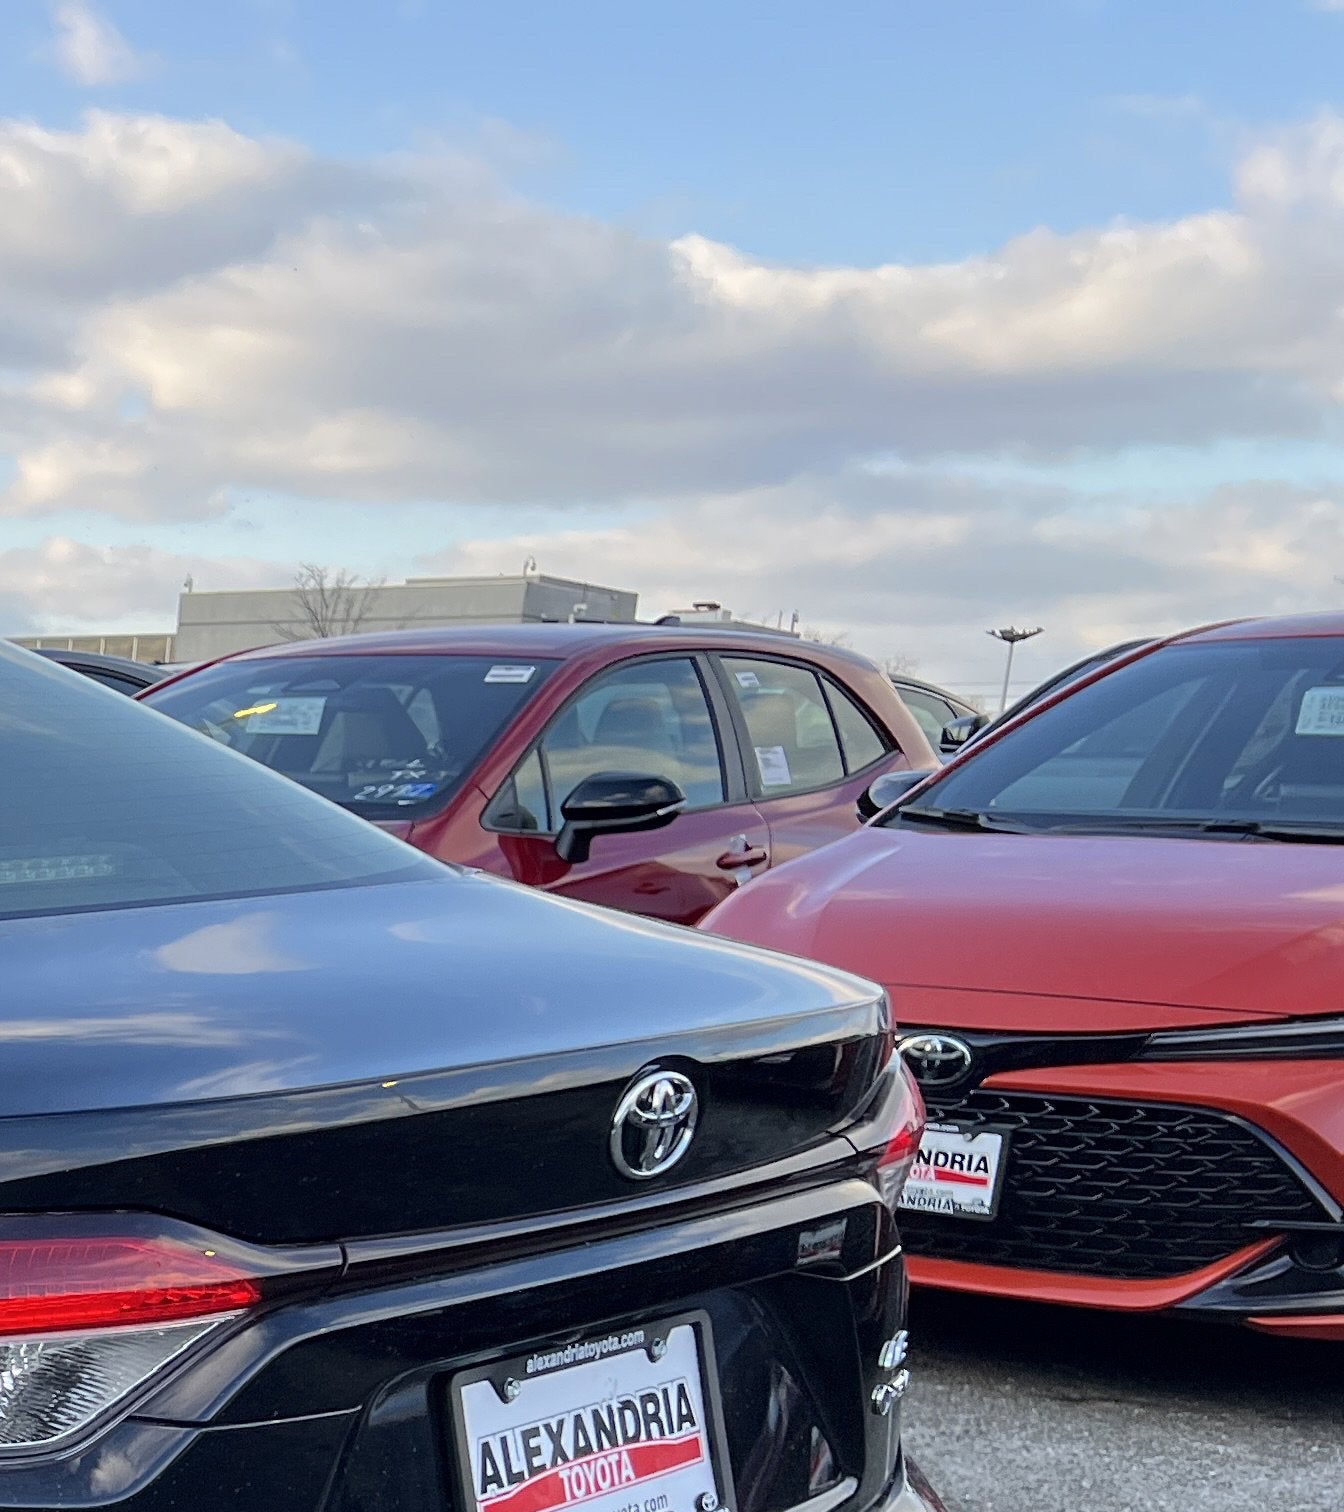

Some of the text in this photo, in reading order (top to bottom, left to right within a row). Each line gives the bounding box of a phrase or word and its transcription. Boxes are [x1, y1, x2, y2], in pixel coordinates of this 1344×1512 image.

[916, 1149, 989, 1174] NDRIA
[525, 1329, 645, 1374] alexandriatoyota.com
[479, 1382, 697, 1496] ALEXANDRIA
[559, 1452, 637, 1502] TOYOTA
